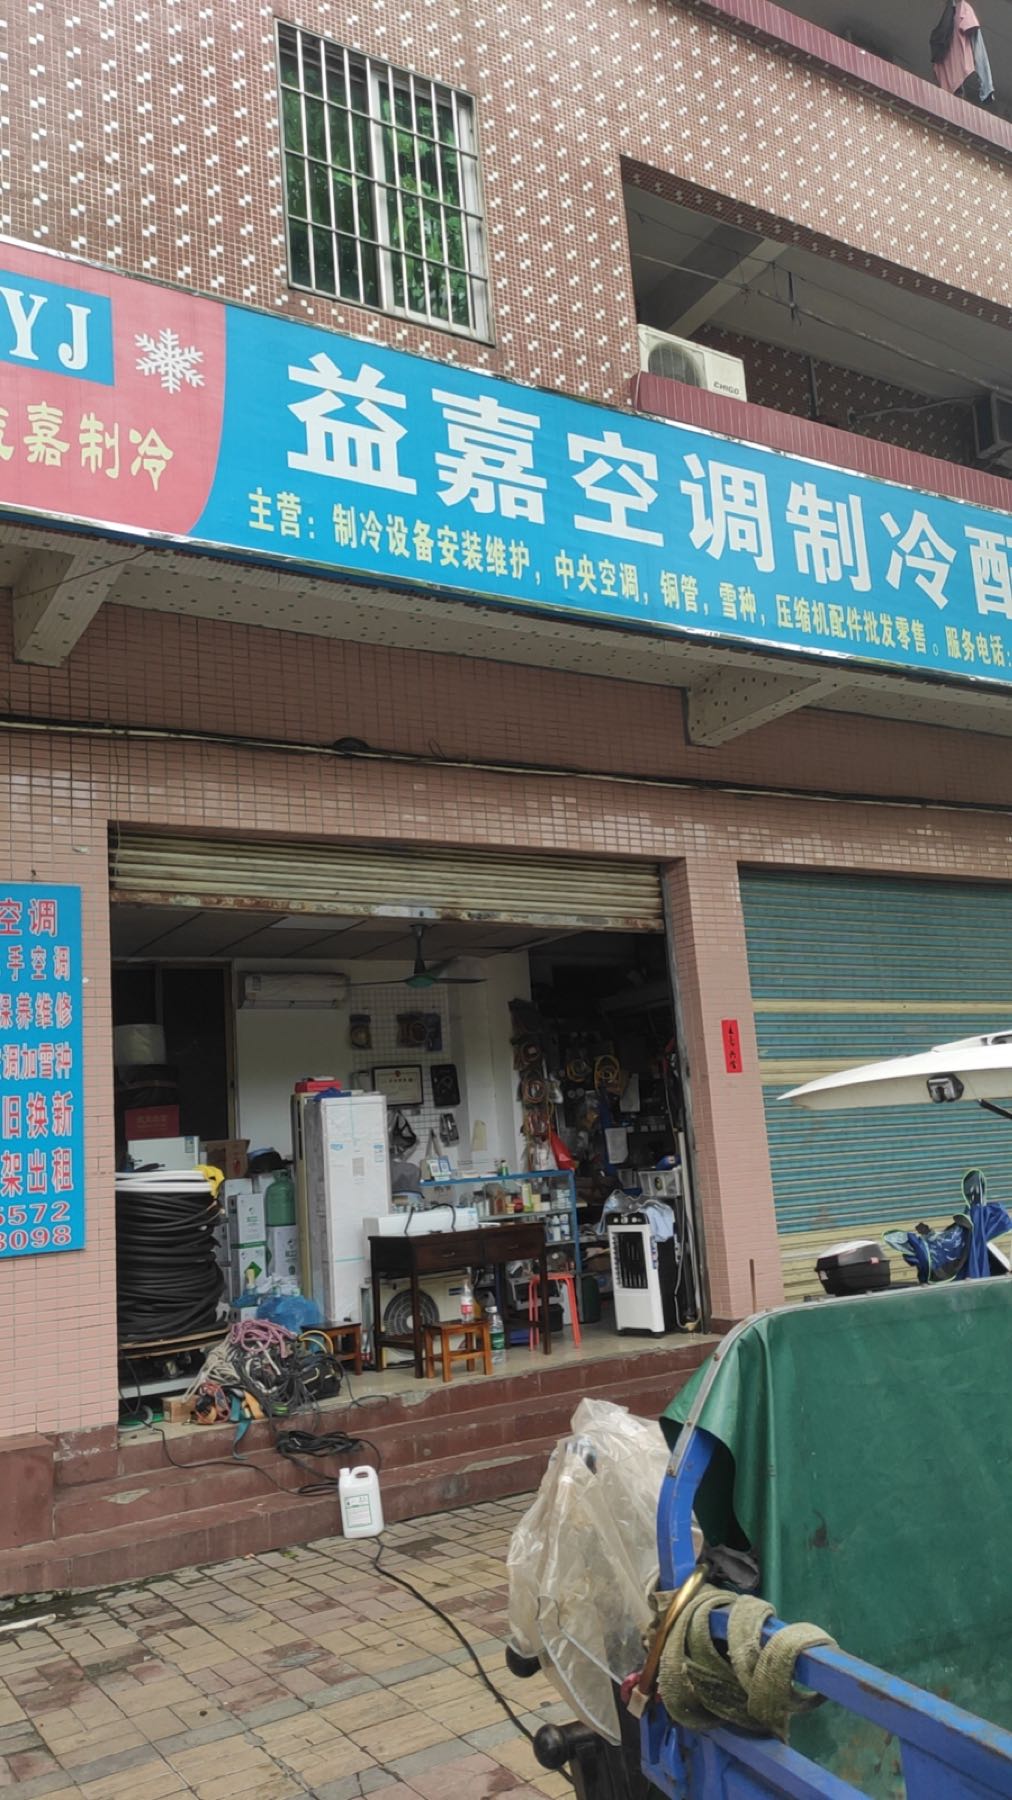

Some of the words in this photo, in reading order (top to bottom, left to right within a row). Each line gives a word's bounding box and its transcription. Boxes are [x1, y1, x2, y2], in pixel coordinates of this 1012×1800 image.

[0, 286, 92, 370] YJ
[0, 897, 57, 936] 空调
[0, 1042, 72, 1080] 调加雪种
[2, 1091, 73, 1139] 旧换新
[0, 1147, 74, 1198] 架出租
